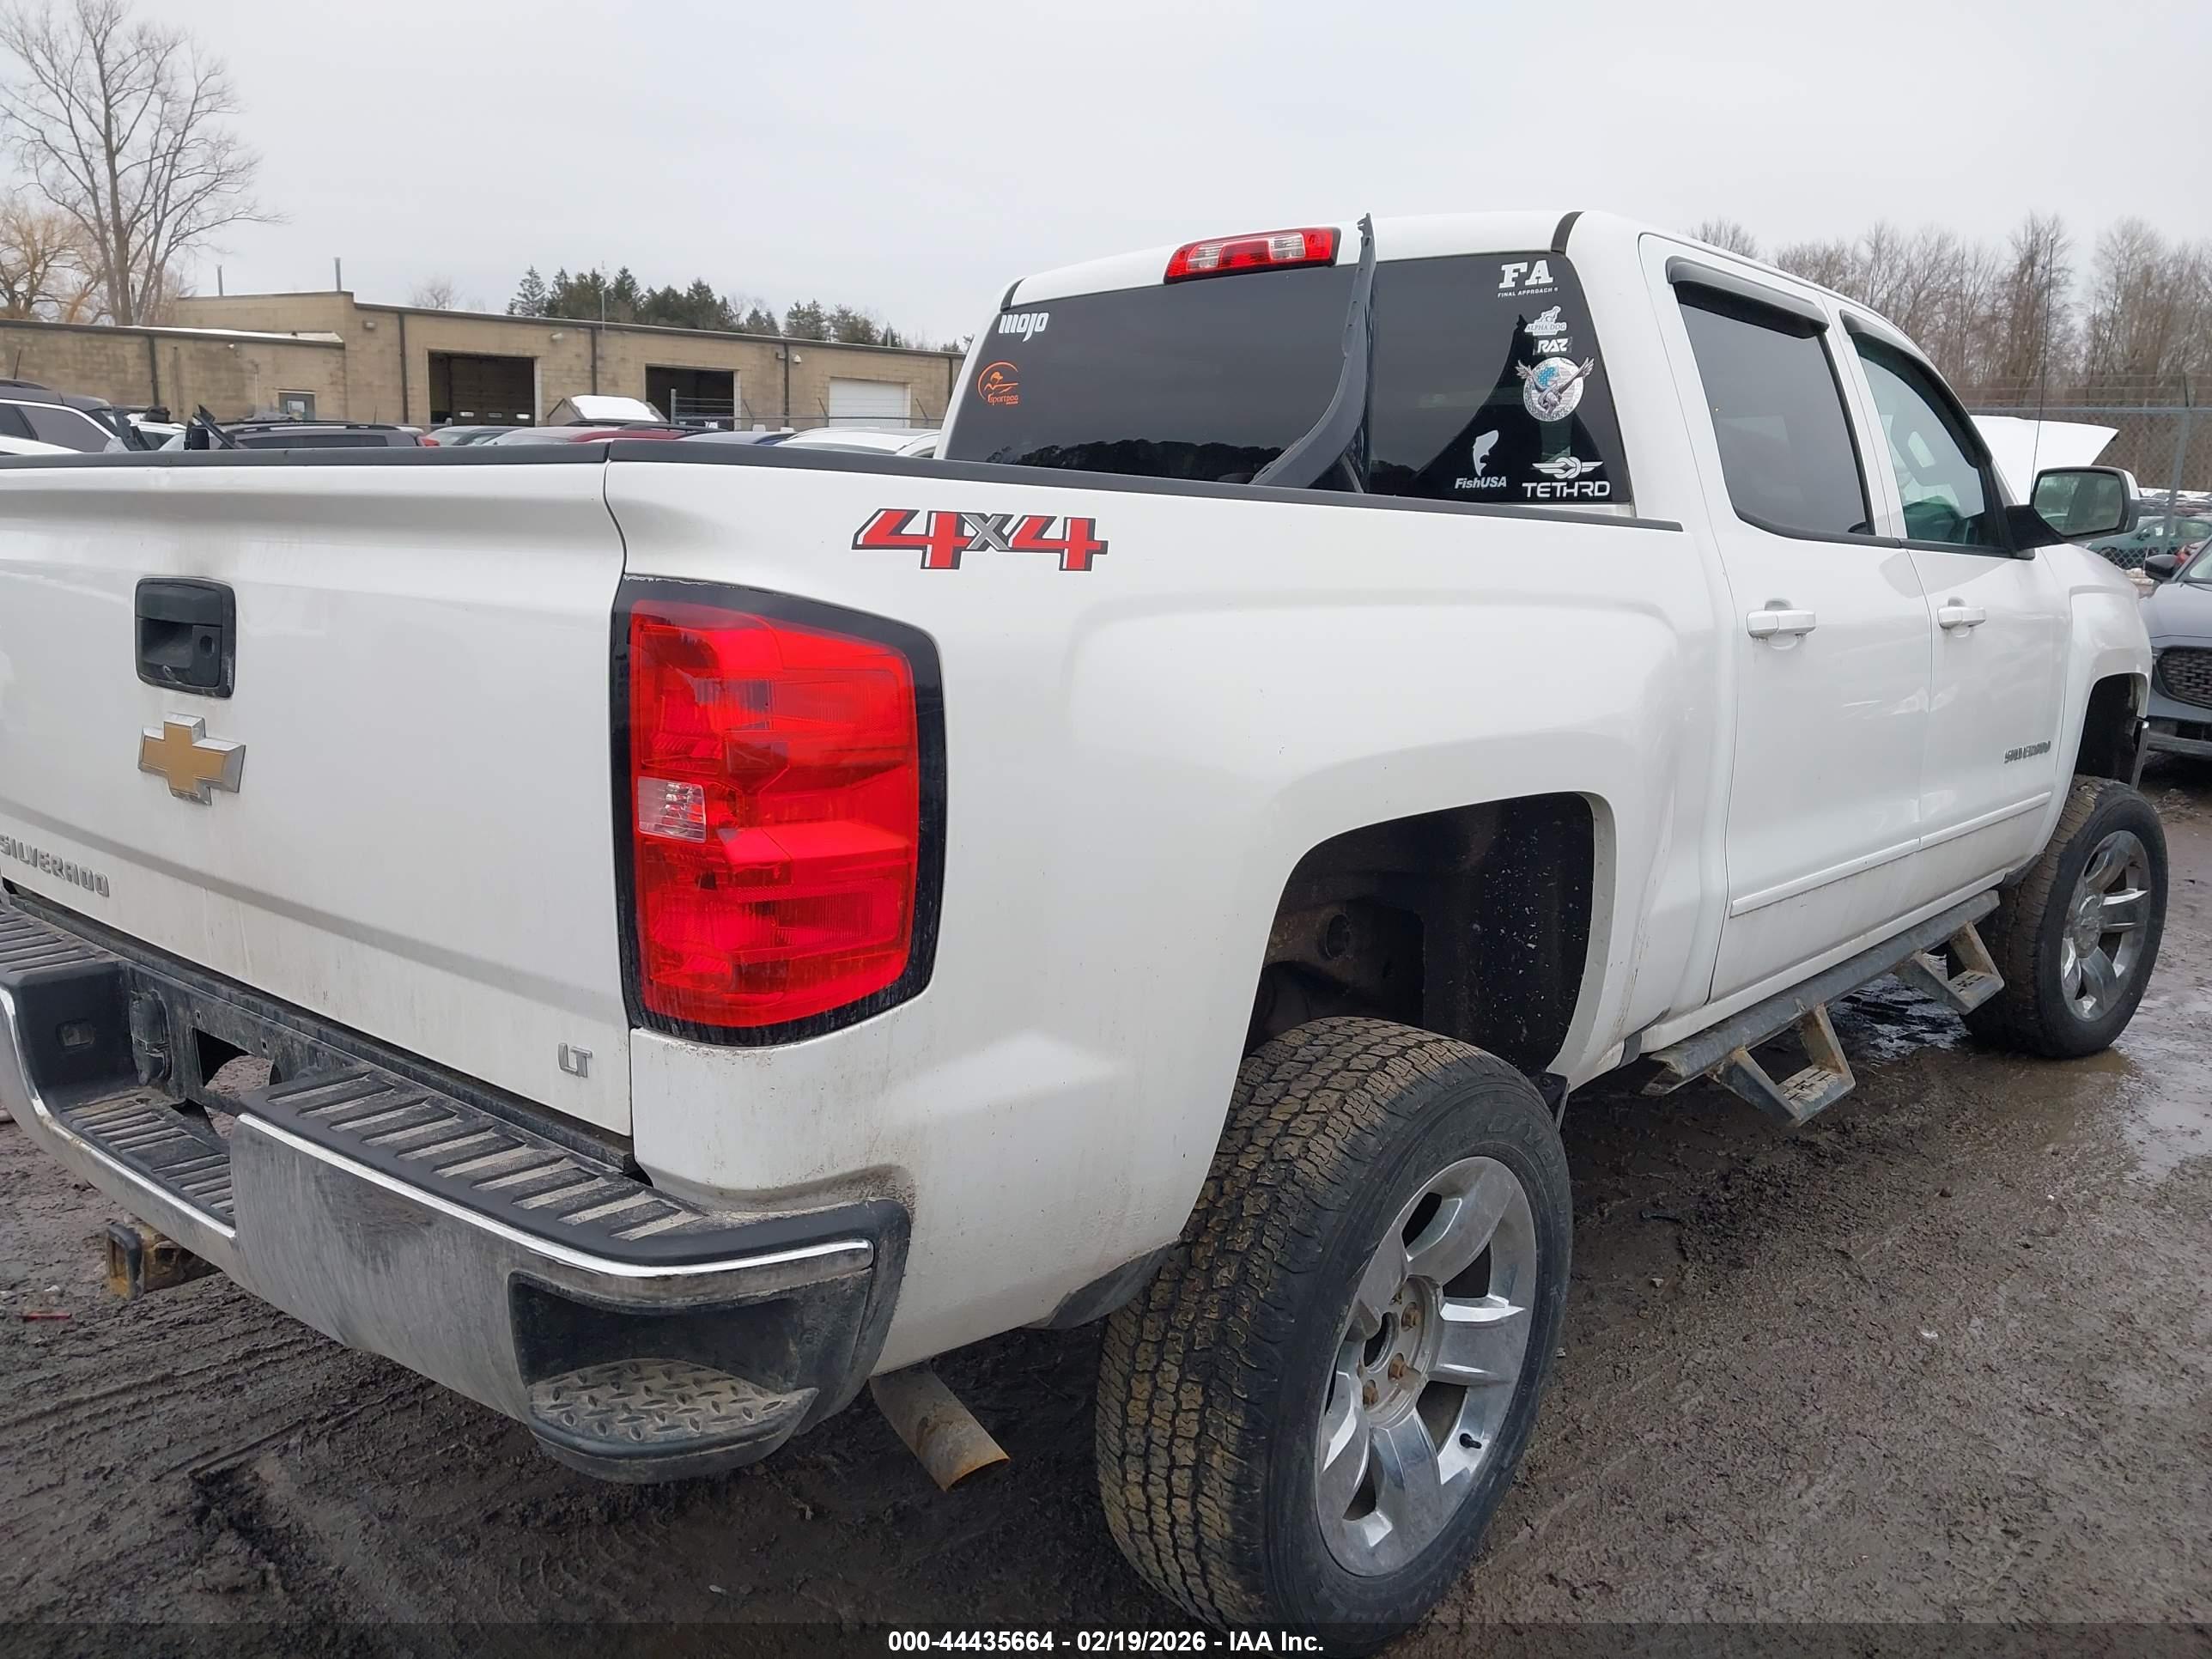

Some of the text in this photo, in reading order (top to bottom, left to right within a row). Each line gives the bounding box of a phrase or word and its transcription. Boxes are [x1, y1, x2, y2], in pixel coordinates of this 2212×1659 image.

[1498, 259, 1553, 289] FA
[1517, 287, 1553, 296] APPROACH
[1537, 337, 1568, 354] RAZ
[1455, 476, 1507, 489] FishUSA
[1522, 481, 1611, 498] TETHRD
[0, 834, 110, 898] SILVERADO
[557, 1042, 592, 1078] LT
